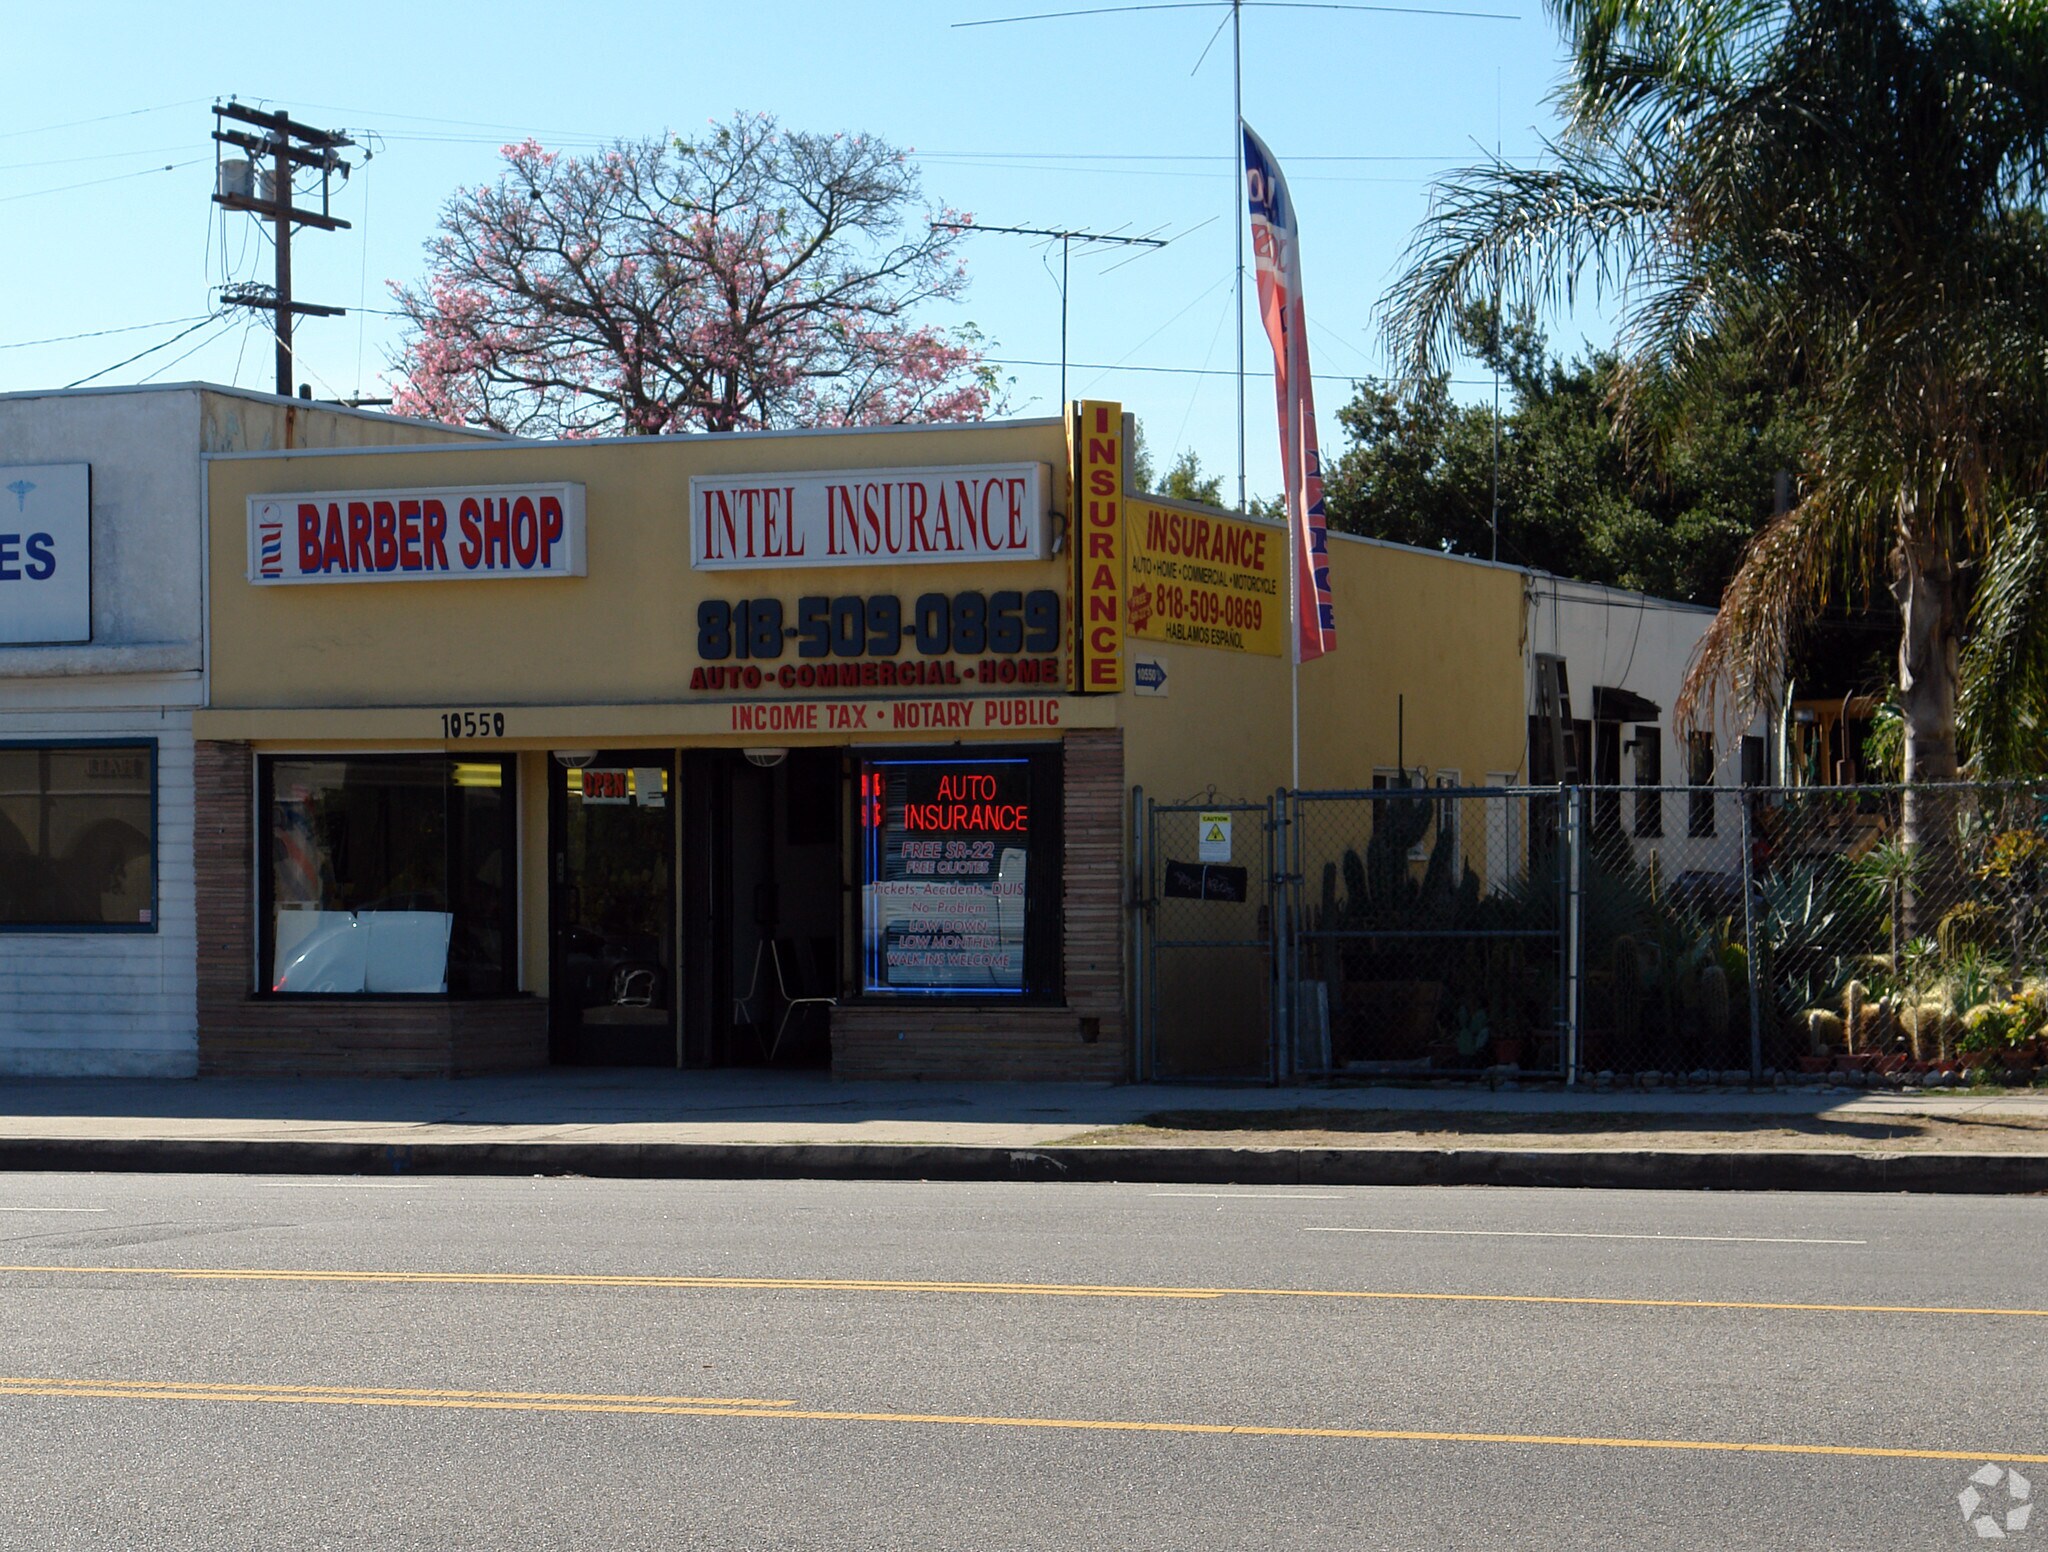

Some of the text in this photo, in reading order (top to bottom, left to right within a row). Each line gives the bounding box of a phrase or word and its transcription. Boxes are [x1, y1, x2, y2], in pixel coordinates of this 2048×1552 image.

[702, 477, 1029, 560] INTEL INSURANCE
[297, 495, 564, 574] BARBER SHOP
[1089, 407, 1118, 685] INSURANCE
[1146, 510, 1267, 571] INSURANCE
[1132, 555, 1277, 596] AUTO HOME COMMERCIAL MOTORCYCLE
[1155, 582, 1263, 632] 818-509-0869
[696, 589, 1061, 661] 818-509-0869
[1165, 622, 1245, 650] HABLAMOS ESPAÑOL
[441, 712, 505, 739] 10550
[731, 699, 1061, 732] INCOME TAX NOTARY PUBLIC
[583, 771, 627, 798] OPEN
[937, 774, 998, 801] AUTO
[904, 803, 1029, 832] INSURANCE
[901, 840, 996, 859] FREE SR-22
[906, 860, 990, 874] FREE QUOTES
[911, 902, 987, 914] No Problem
[909, 919, 988, 933] LOW DOWN
[899, 935, 998, 950] LOW MONTHLY
[947, 954, 1010, 968] WELCOME
